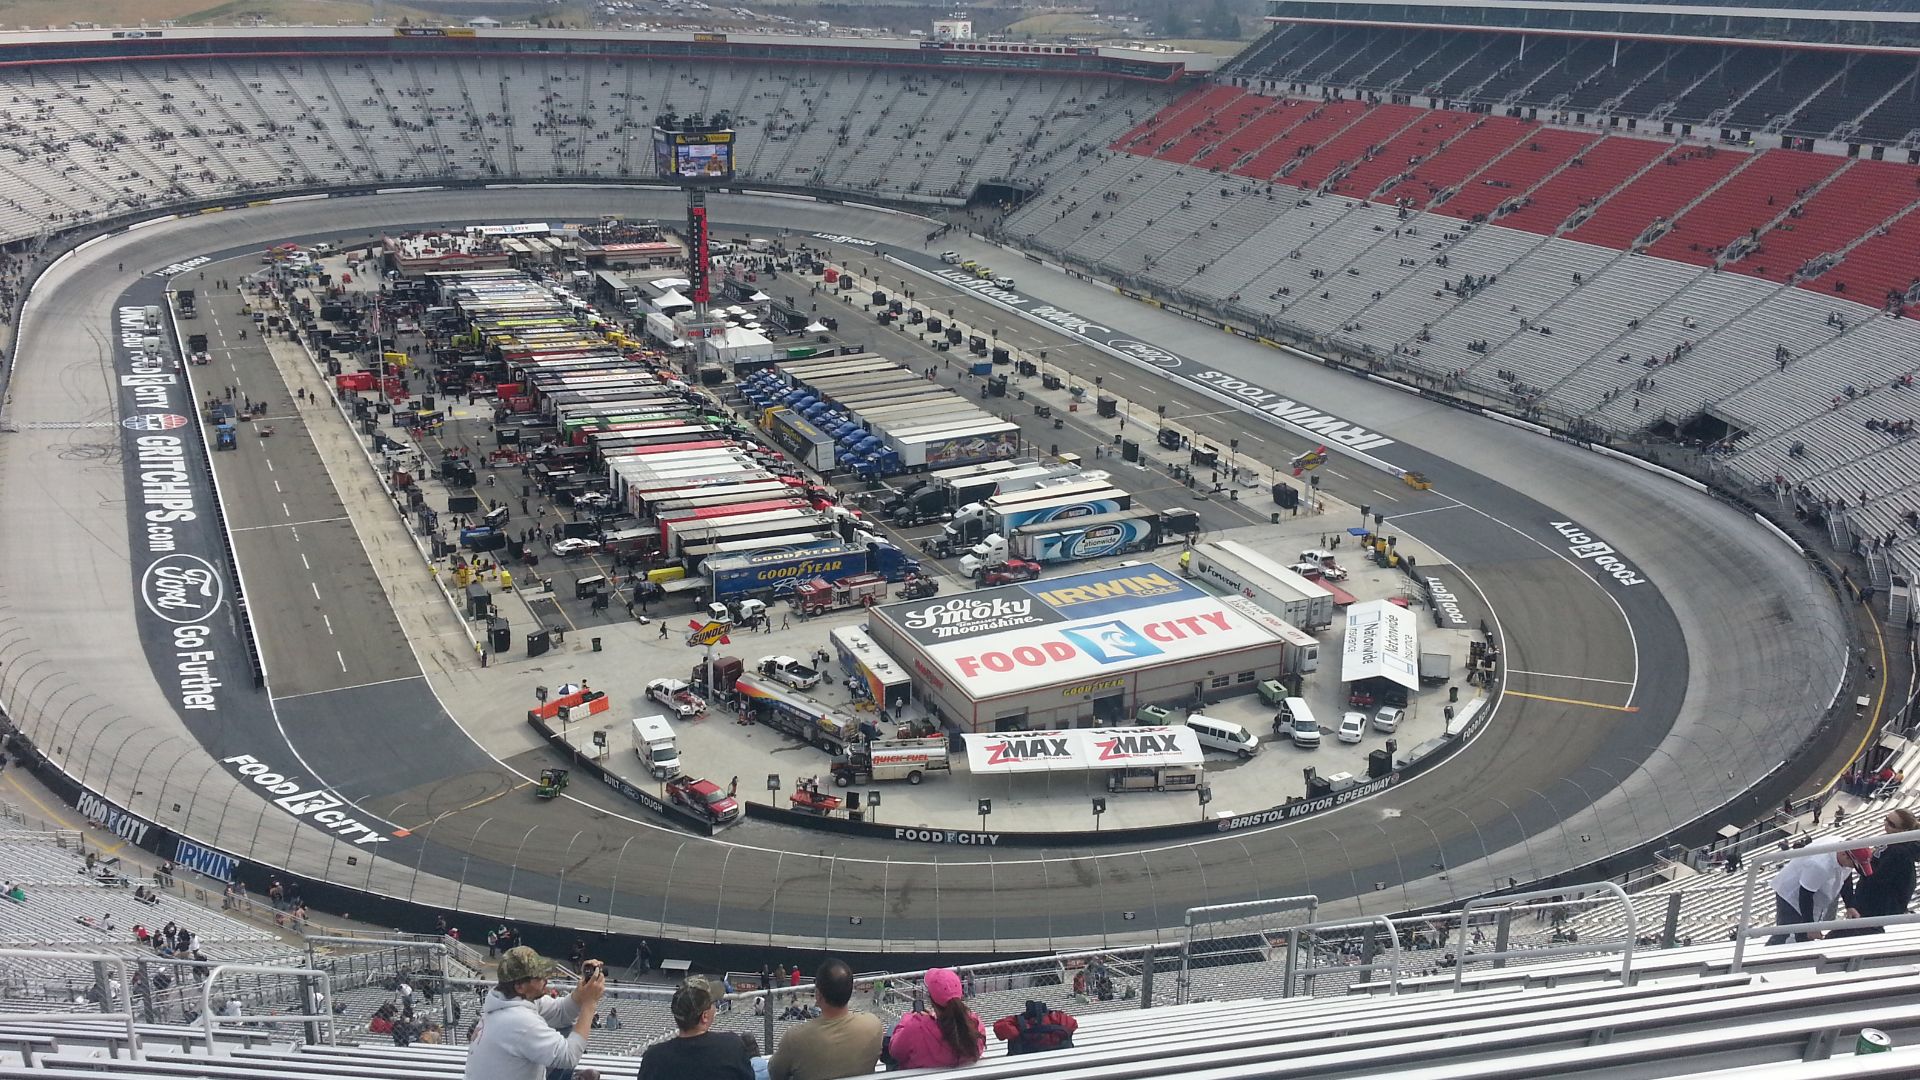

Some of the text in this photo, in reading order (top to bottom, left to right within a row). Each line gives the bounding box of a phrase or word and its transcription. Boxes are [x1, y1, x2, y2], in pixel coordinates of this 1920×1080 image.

[932, 268, 1029, 305] FOOD CITY
[1118, 342, 1174, 363] Ford
[134, 385, 169, 408] CITY
[1196, 370, 1277, 403] TOOLS
[1261, 398, 1396, 451] IRWIN
[136, 435, 197, 552] GRITCHIPS.com
[752, 547, 841, 563] GOODYEAR
[1085, 537, 1117, 548] ationwide
[1550, 521, 1646, 586] FOOD CITY
[757, 560, 842, 581] GOODYEAR
[1206, 565, 1256, 599] Forward Air
[154, 566, 212, 610] Ford
[1038, 573, 1173, 607] IRWIN
[1134, 584, 1179, 597] TOOLS
[1426, 576, 1468, 624] FOOD CITY
[904, 598, 1033, 630] Smoky
[946, 599, 984, 612] Ole
[692, 622, 732, 646] SUNOCO
[931, 614, 1044, 638] Moonshine
[1385, 614, 1399, 656] Nationwide
[955, 610, 1233, 678] FOOD CITY
[1362, 622, 1379, 665] Nationwide
[173, 625, 222, 711] Go Further
[1063, 679, 1125, 697] GOODYEAR
[1462, 719, 1479, 742] FOOD
[873, 754, 929, 765] QUICK-FUEL
[224, 754, 390, 845] FOOD CITY
[603, 772, 620, 789] BUILT
[640, 794, 663, 813] TOUGH
[1229, 775, 1392, 830] BRISTOL MOTOR SPEEDWAY
[76, 791, 149, 846] FOOD CITY
[895, 828, 943, 843] FOOD
[958, 833, 1000, 845] CITY
[174, 840, 236, 882] IRWIN
